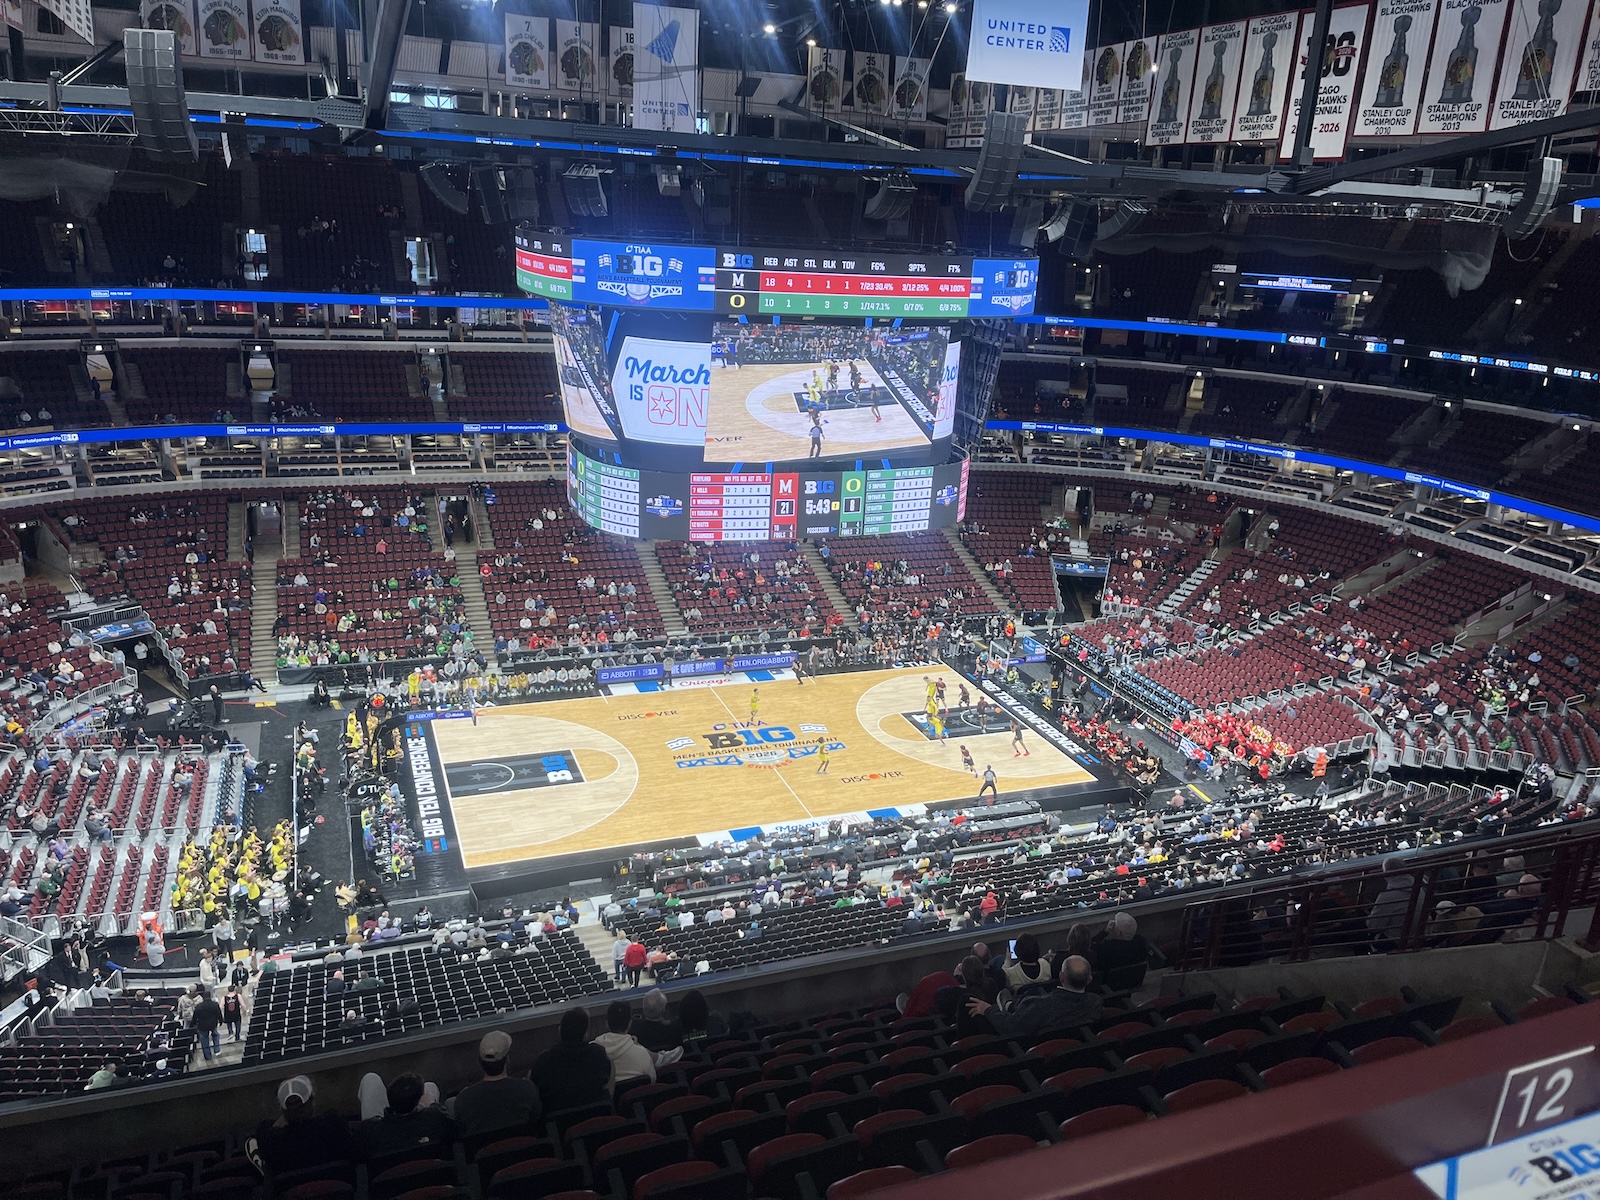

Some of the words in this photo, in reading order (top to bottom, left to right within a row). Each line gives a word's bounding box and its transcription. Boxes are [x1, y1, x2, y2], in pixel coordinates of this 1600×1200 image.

[1381, 4, 1431, 16] BLACKHAWKS
[1260, 15, 1286, 26] CHICAGO
[524, 21, 530, 32] 7
[988, 19, 1046, 34] UNITED
[1212, 24, 1236, 34] CHICAGO
[1252, 22, 1292, 34] BLACKHAWKS
[1168, 32, 1190, 42] CHICAGO
[1204, 30, 1240, 42] BLACKHAWKS
[987, 36, 1044, 50] CENTER
[1162, 38, 1194, 50] BLACKHAWKS
[866, 56, 876, 66] 35
[642, 100, 675, 108] UNITED
[1427, 104, 1461, 112] STANLEY
[1464, 103, 1482, 112] CUP
[1500, 100, 1536, 110] STANLEY
[1540, 100, 1561, 110] CUP
[642, 108, 675, 116] CENTER
[1362, 109, 1392, 118] STANLEY
[1429, 113, 1477, 122] CHAMPIONS
[1502, 110, 1555, 119] CHAMPIONS
[1192, 120, 1214, 128] STANLEY
[1238, 116, 1263, 124] STANLEY
[1364, 117, 1406, 126] CHAMPIONS
[1150, 123, 1172, 131] STANLEY
[1192, 126, 1224, 134] CHAMPIONS
[1240, 124, 1274, 132] CHAMPIONS
[1319, 122, 1340, 132] 2026
[1375, 126, 1391, 134] 2010
[1442, 122, 1460, 130] 2013
[1152, 130, 1180, 138] CHAMPIONS
[634, 246, 652, 254] TIAA
[764, 257, 778, 266] REB
[784, 258, 798, 267] AST
[804, 259, 816, 268] STL
[823, 260, 836, 268] BLK
[842, 260, 856, 270] TOV
[870, 262, 885, 270] FG%
[908, 264, 926, 272] 3PT%
[948, 265, 960, 273] FT%
[732, 274, 744, 286] M
[766, 278, 776, 286] 18
[787, 279, 792, 287] 4
[826, 280, 830, 288] 1
[844, 281, 849, 289] 1
[860, 282, 874, 290] 7/23
[730, 294, 746, 308] O
[764, 298, 774, 306] 10
[806, 300, 810, 308] 1
[1496, 359, 1509, 367] FT%
[624, 356, 710, 384] March
[630, 384, 643, 401] IS
[779, 479, 792, 494] M
[846, 478, 861, 492] O
[780, 502, 789, 514] 21
[806, 499, 830, 514] 5:43
[850, 499, 855, 511] 8
[734, 656, 792, 668] GTEN.ORG/ABBOTT
[905, 660, 939, 668] TIAA
[680, 664, 695, 674] GIVE
[696, 662, 717, 672] BLOOD
[610, 670, 636, 678] ABBOTT
[680, 678, 732, 687] Chicago
[618, 710, 678, 721] DISCOVER
[982, 680, 1002, 692] BIG
[994, 691, 1022, 706] TEN
[1012, 704, 1086, 754] CONFERENCE
[730, 720, 768, 728] TIAA
[672, 752, 706, 760] MEN'S
[708, 744, 772, 758] BASKETBALL
[773, 736, 838, 749] TOURNAMNT
[407, 736, 436, 796] CONFERENCE
[841, 770, 904, 784] DISCOVER
[417, 796, 440, 818] TEN
[422, 818, 445, 838] BIG
[775, 821, 820, 833] March
[1516, 1067, 1574, 1128] 12
